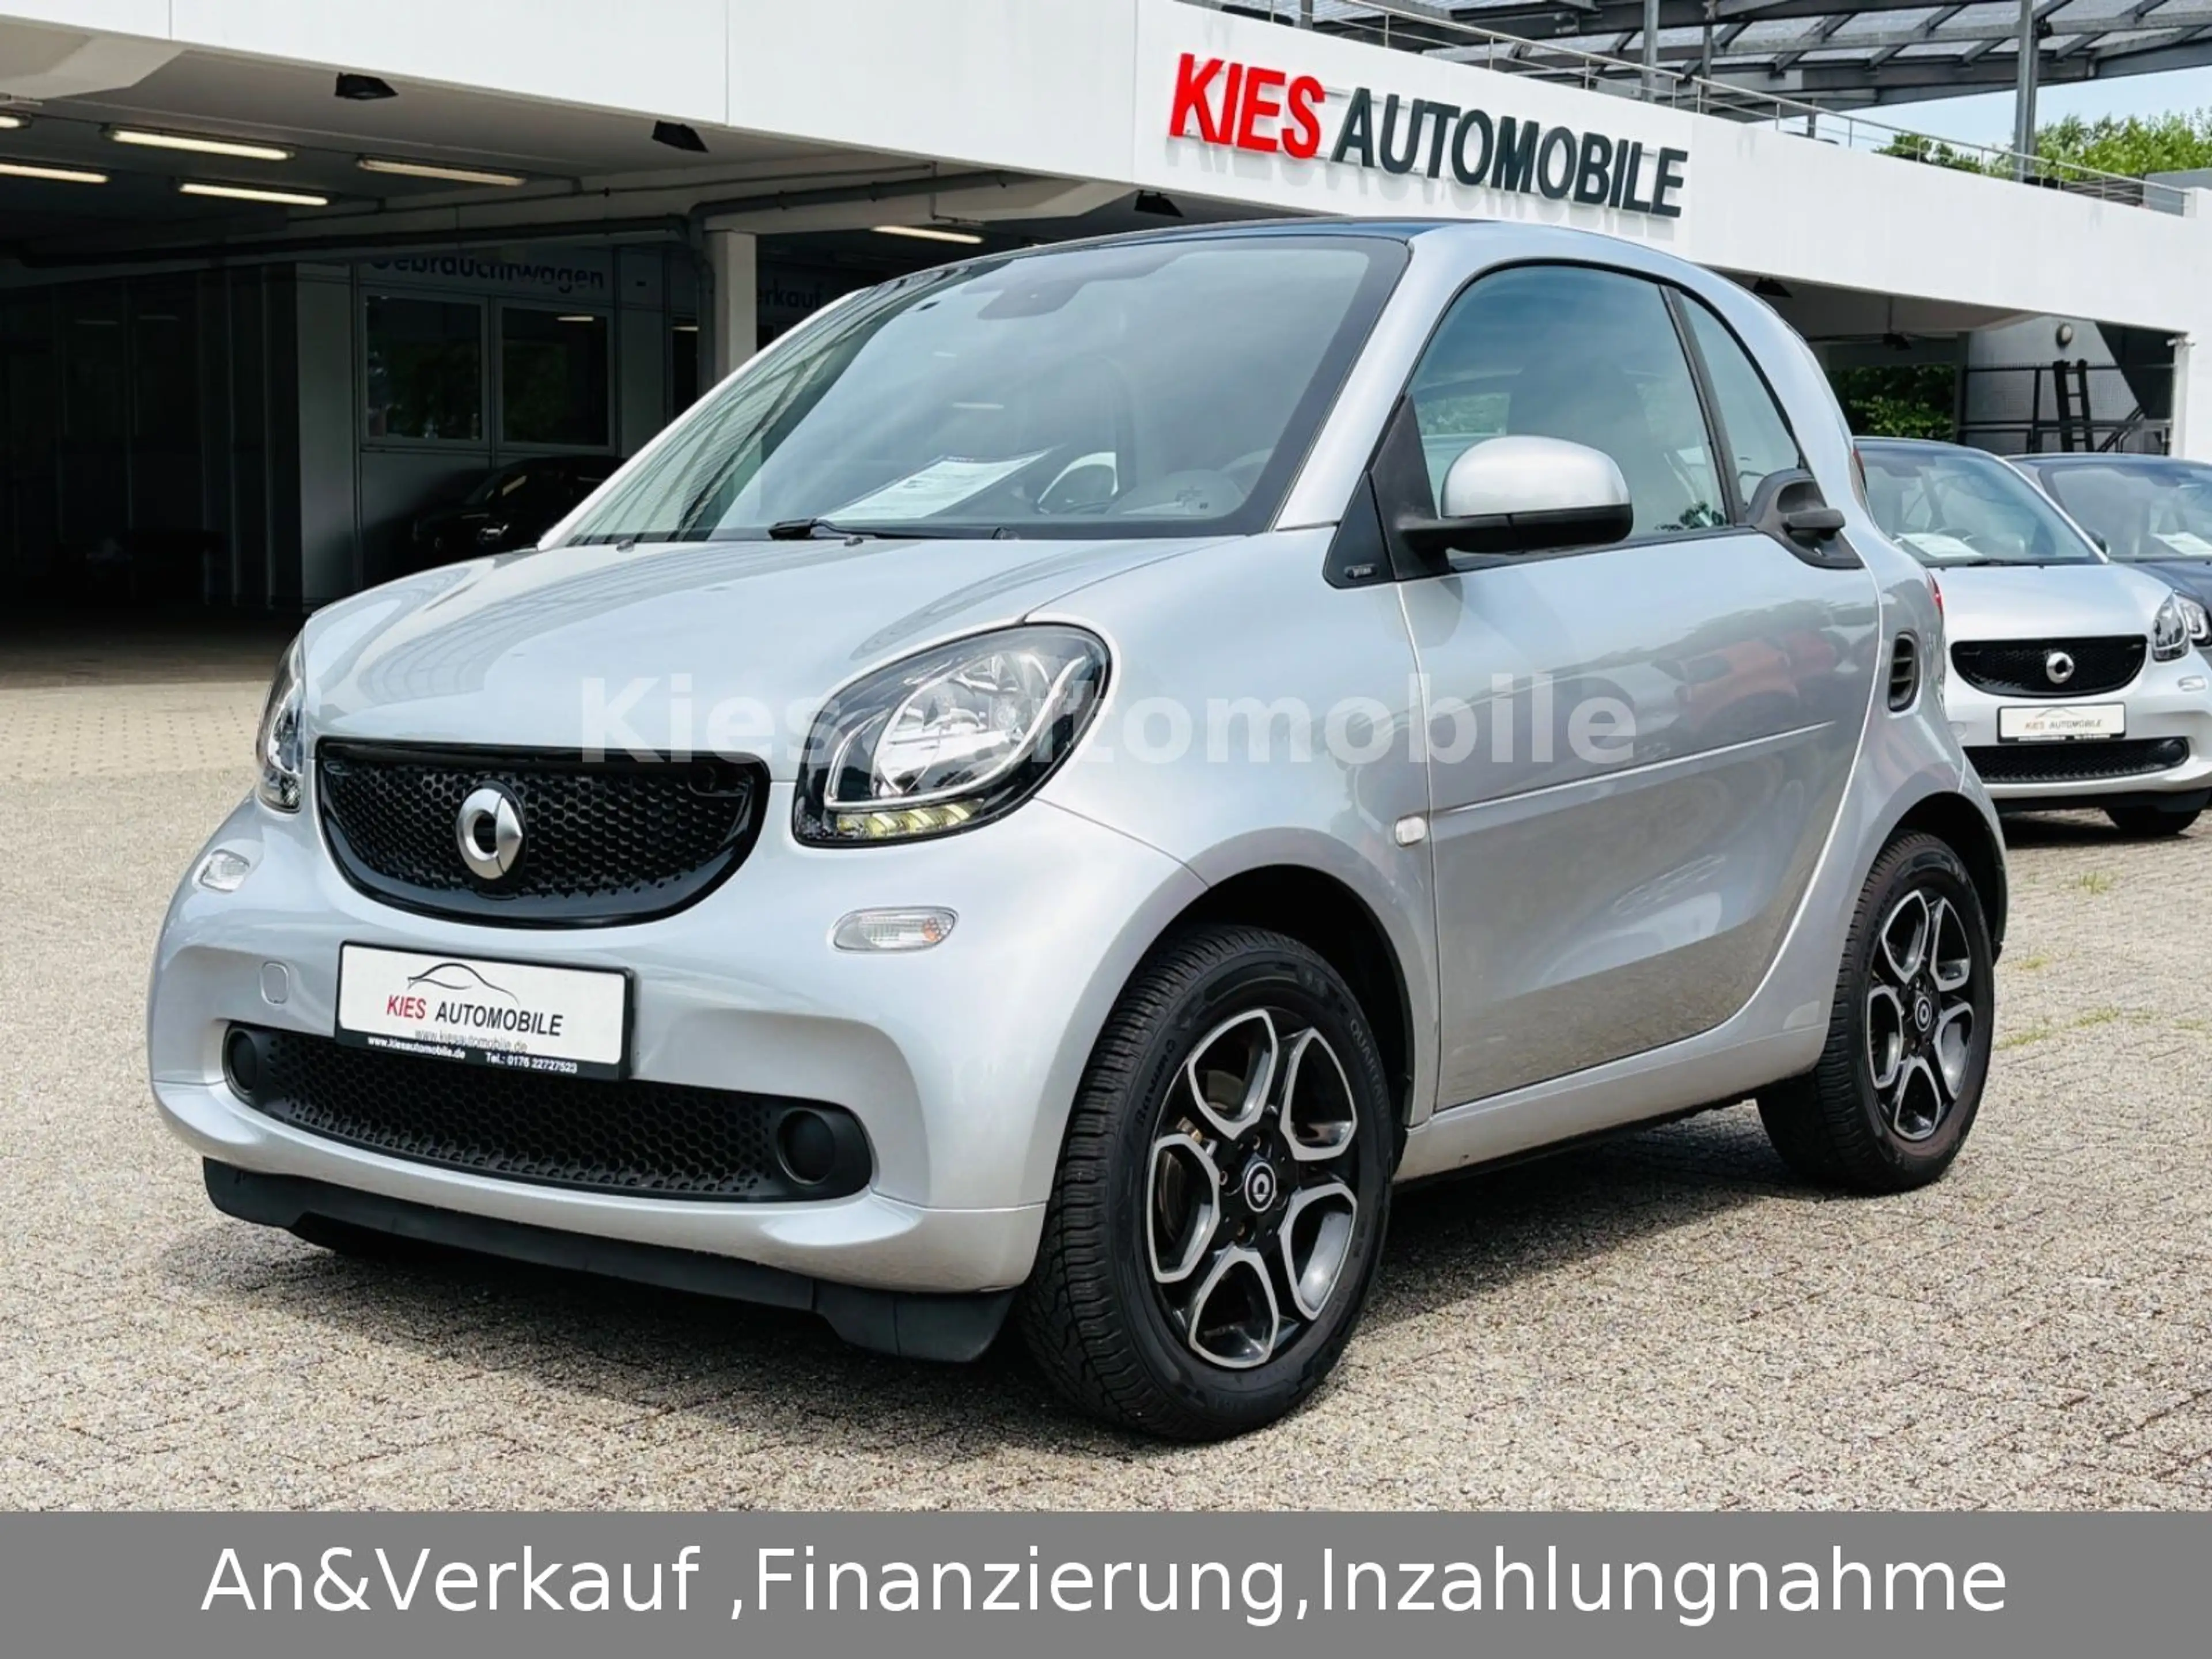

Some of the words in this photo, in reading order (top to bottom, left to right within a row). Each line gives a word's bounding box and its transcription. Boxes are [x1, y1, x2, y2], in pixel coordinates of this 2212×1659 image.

[1169, 52, 1324, 159] KIES
[1331, 88, 1689, 218] AUTOMOBILE
[387, 995, 427, 1020] KIES
[435, 1001, 564, 1036] AUTOMOBILE
